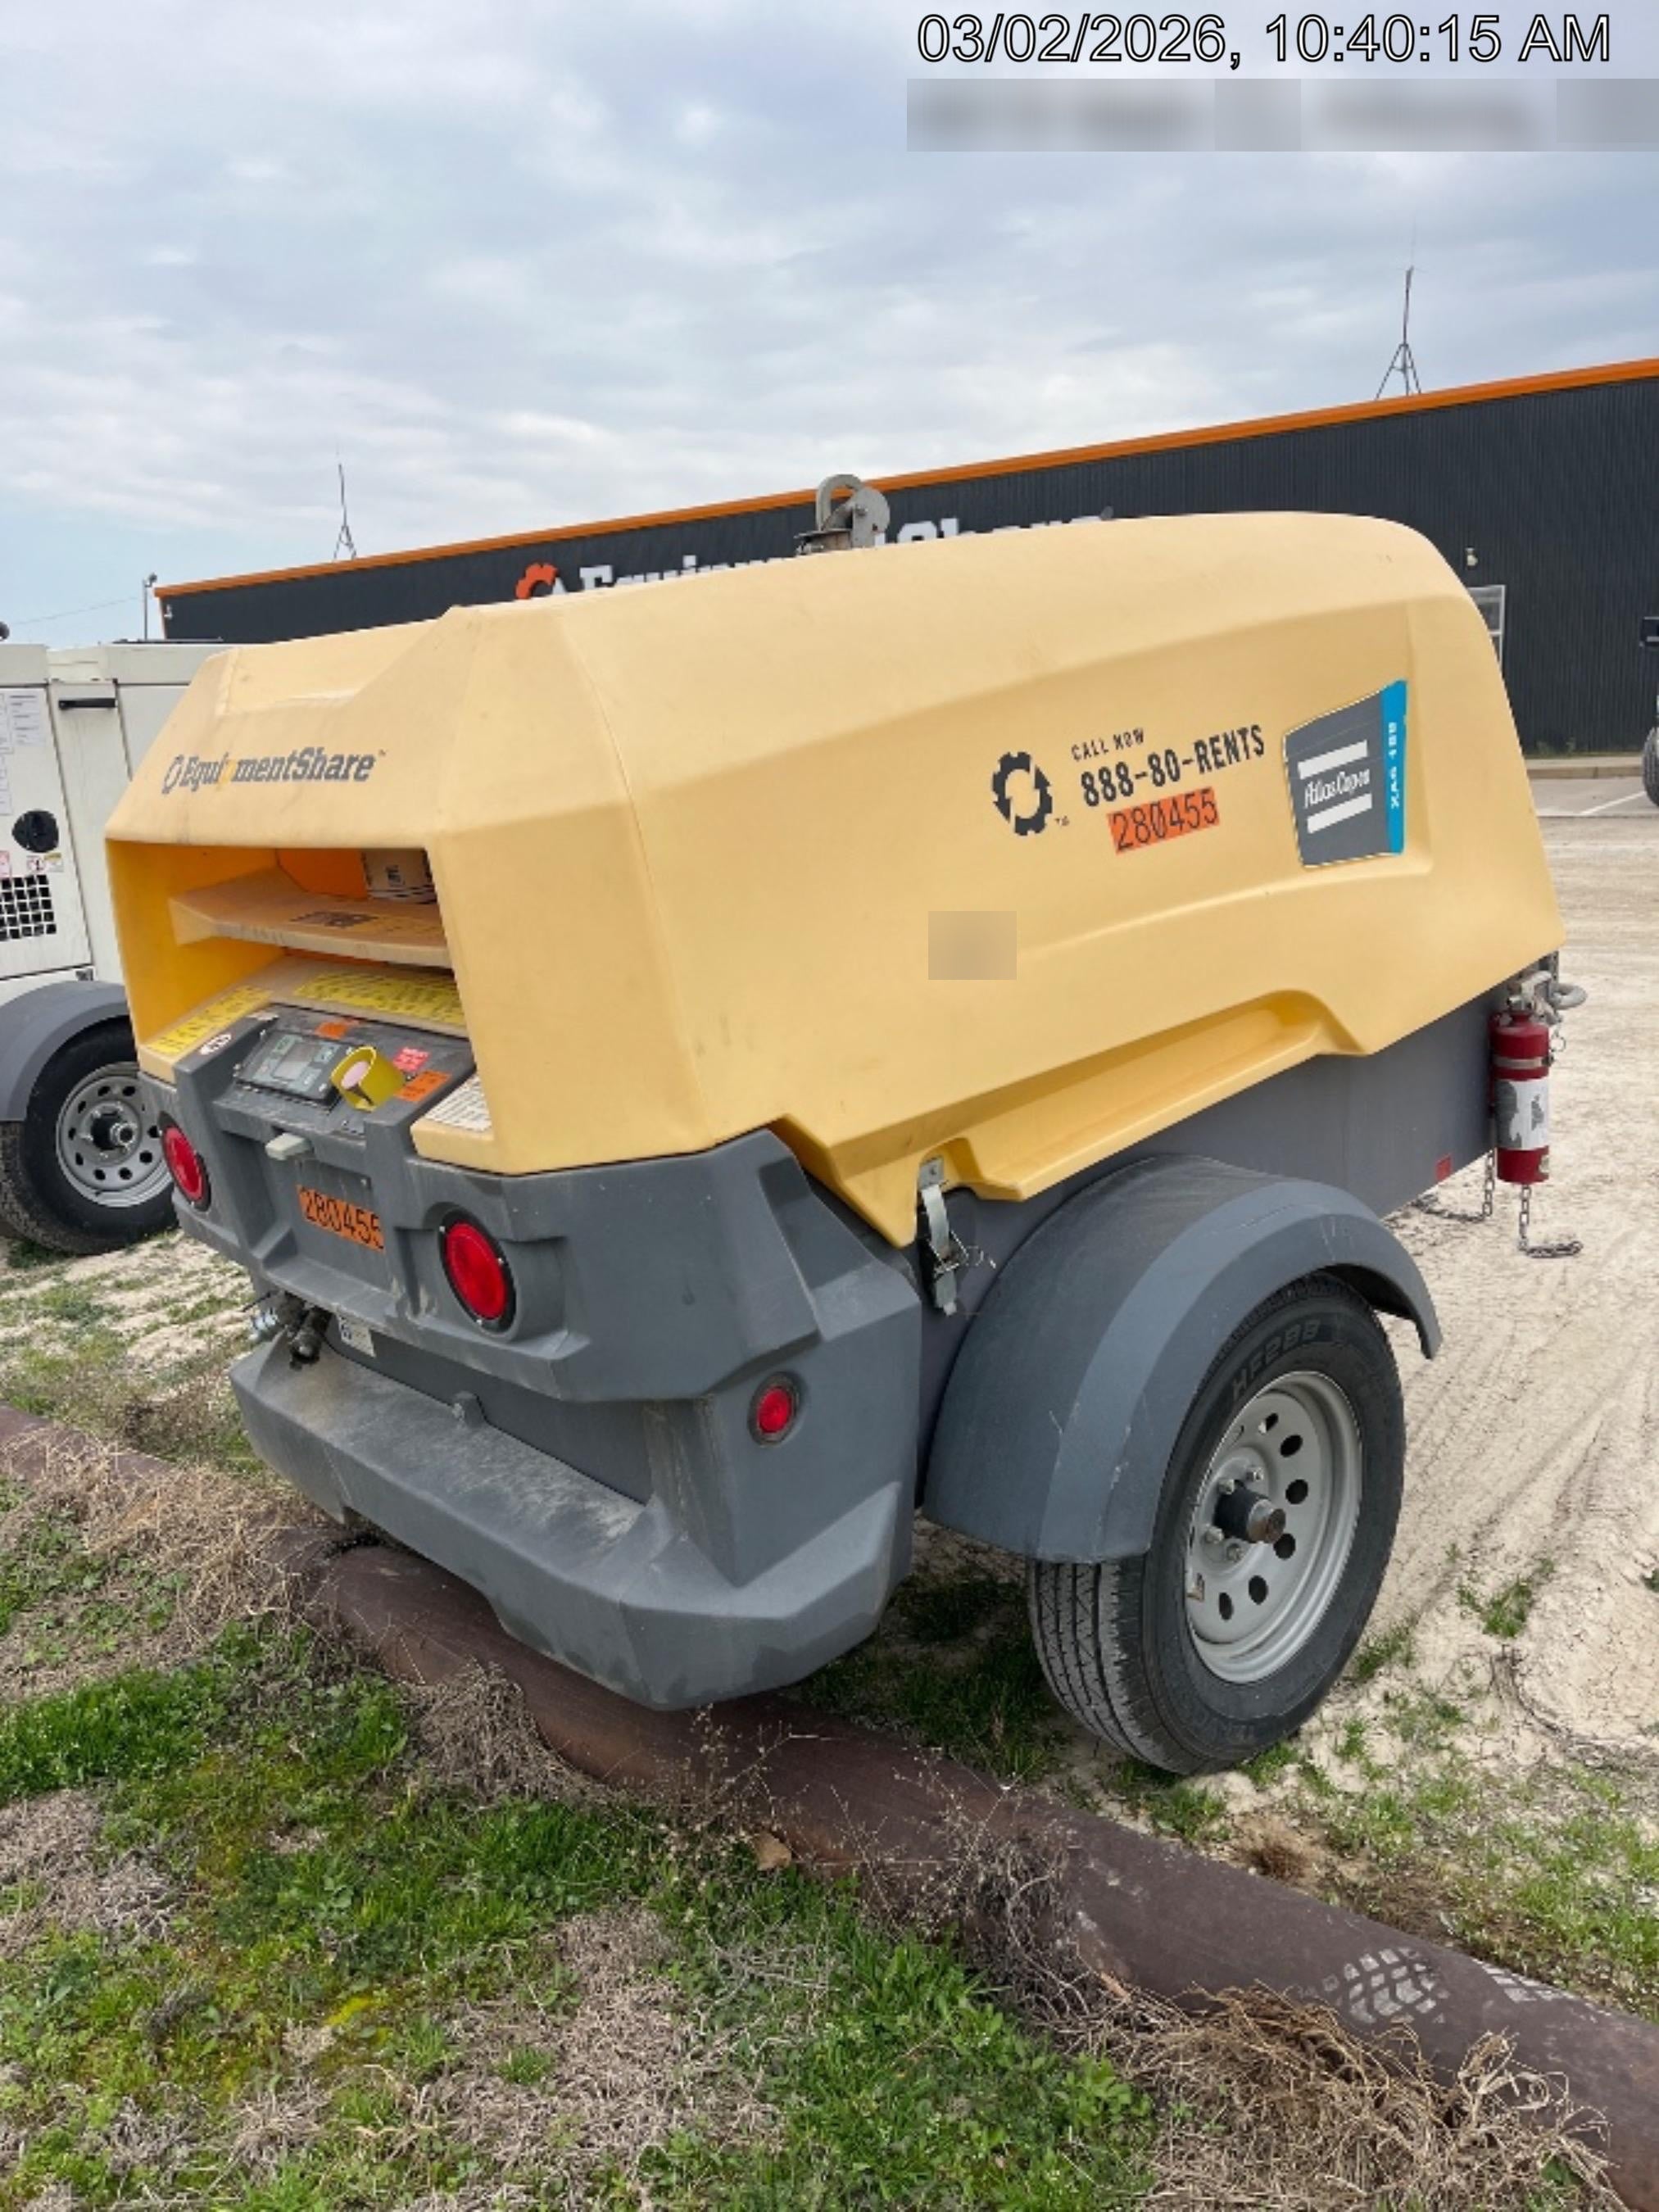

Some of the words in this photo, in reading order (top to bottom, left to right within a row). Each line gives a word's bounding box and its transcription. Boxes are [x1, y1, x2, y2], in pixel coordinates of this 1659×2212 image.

[179, 746, 376, 793] EquimentShare
[1071, 737, 1109, 762] CALL
[1113, 727, 1145, 751] NOW
[1081, 724, 1265, 807] 888-80-RENTS
[1112, 787, 1219, 852] 280455
[301, 1185, 385, 1250] 280455
